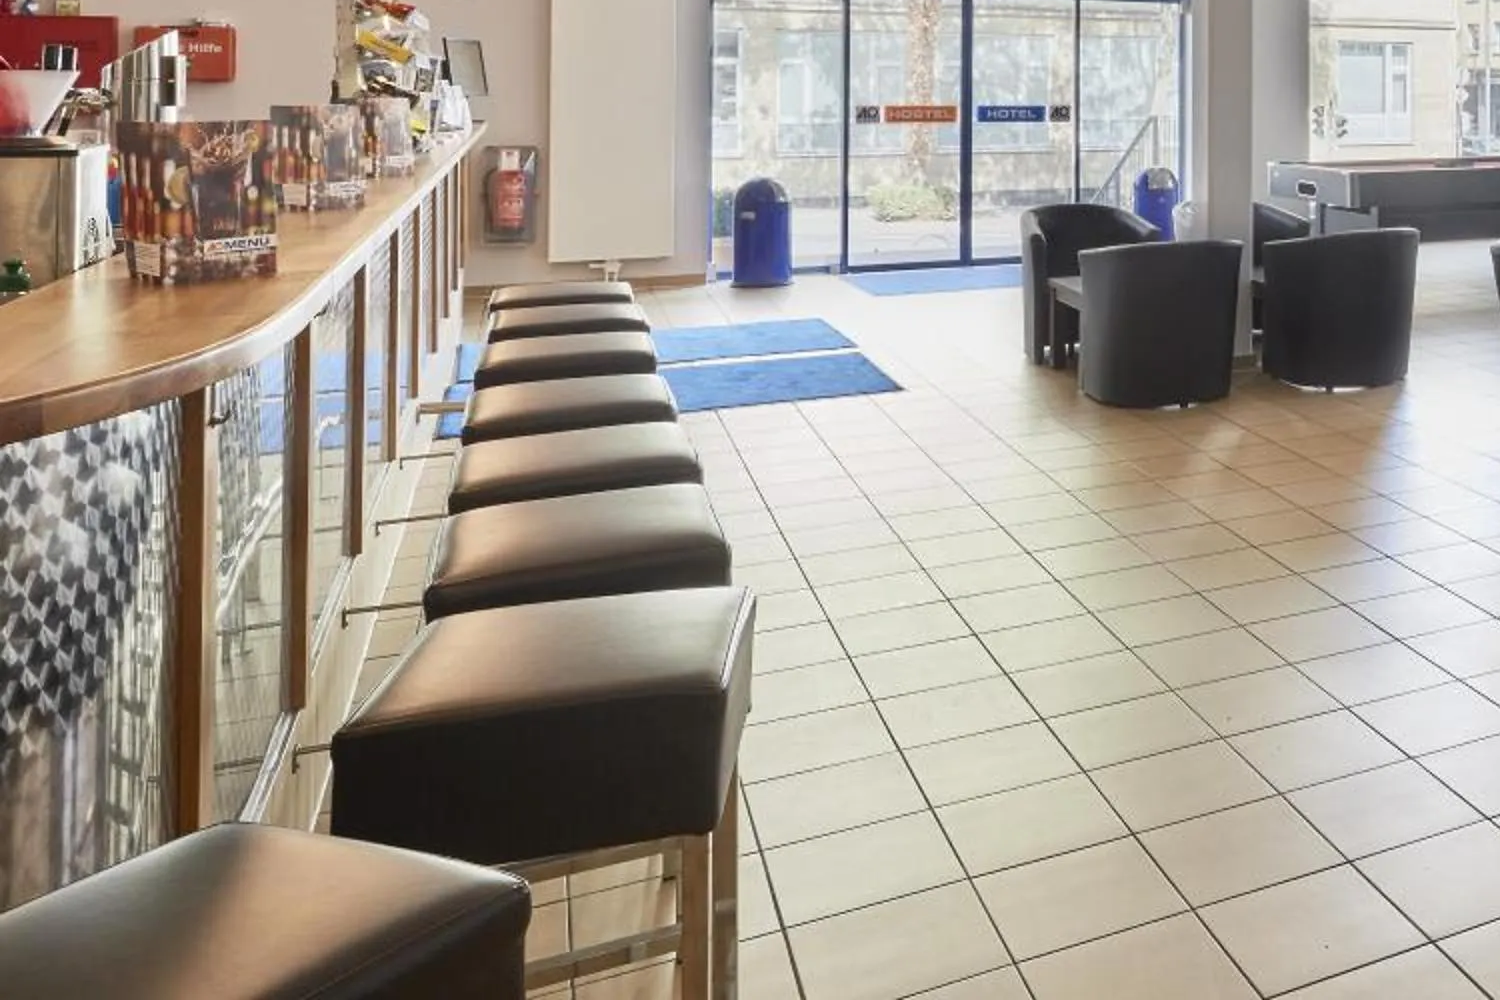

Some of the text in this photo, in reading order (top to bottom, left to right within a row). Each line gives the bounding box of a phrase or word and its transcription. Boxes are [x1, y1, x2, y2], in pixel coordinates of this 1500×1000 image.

[187, 42, 223, 53] Hilfe
[887, 108, 952, 120] HOSTEL
[986, 108, 1037, 119] HOTEL
[224, 237, 270, 249] MENU
